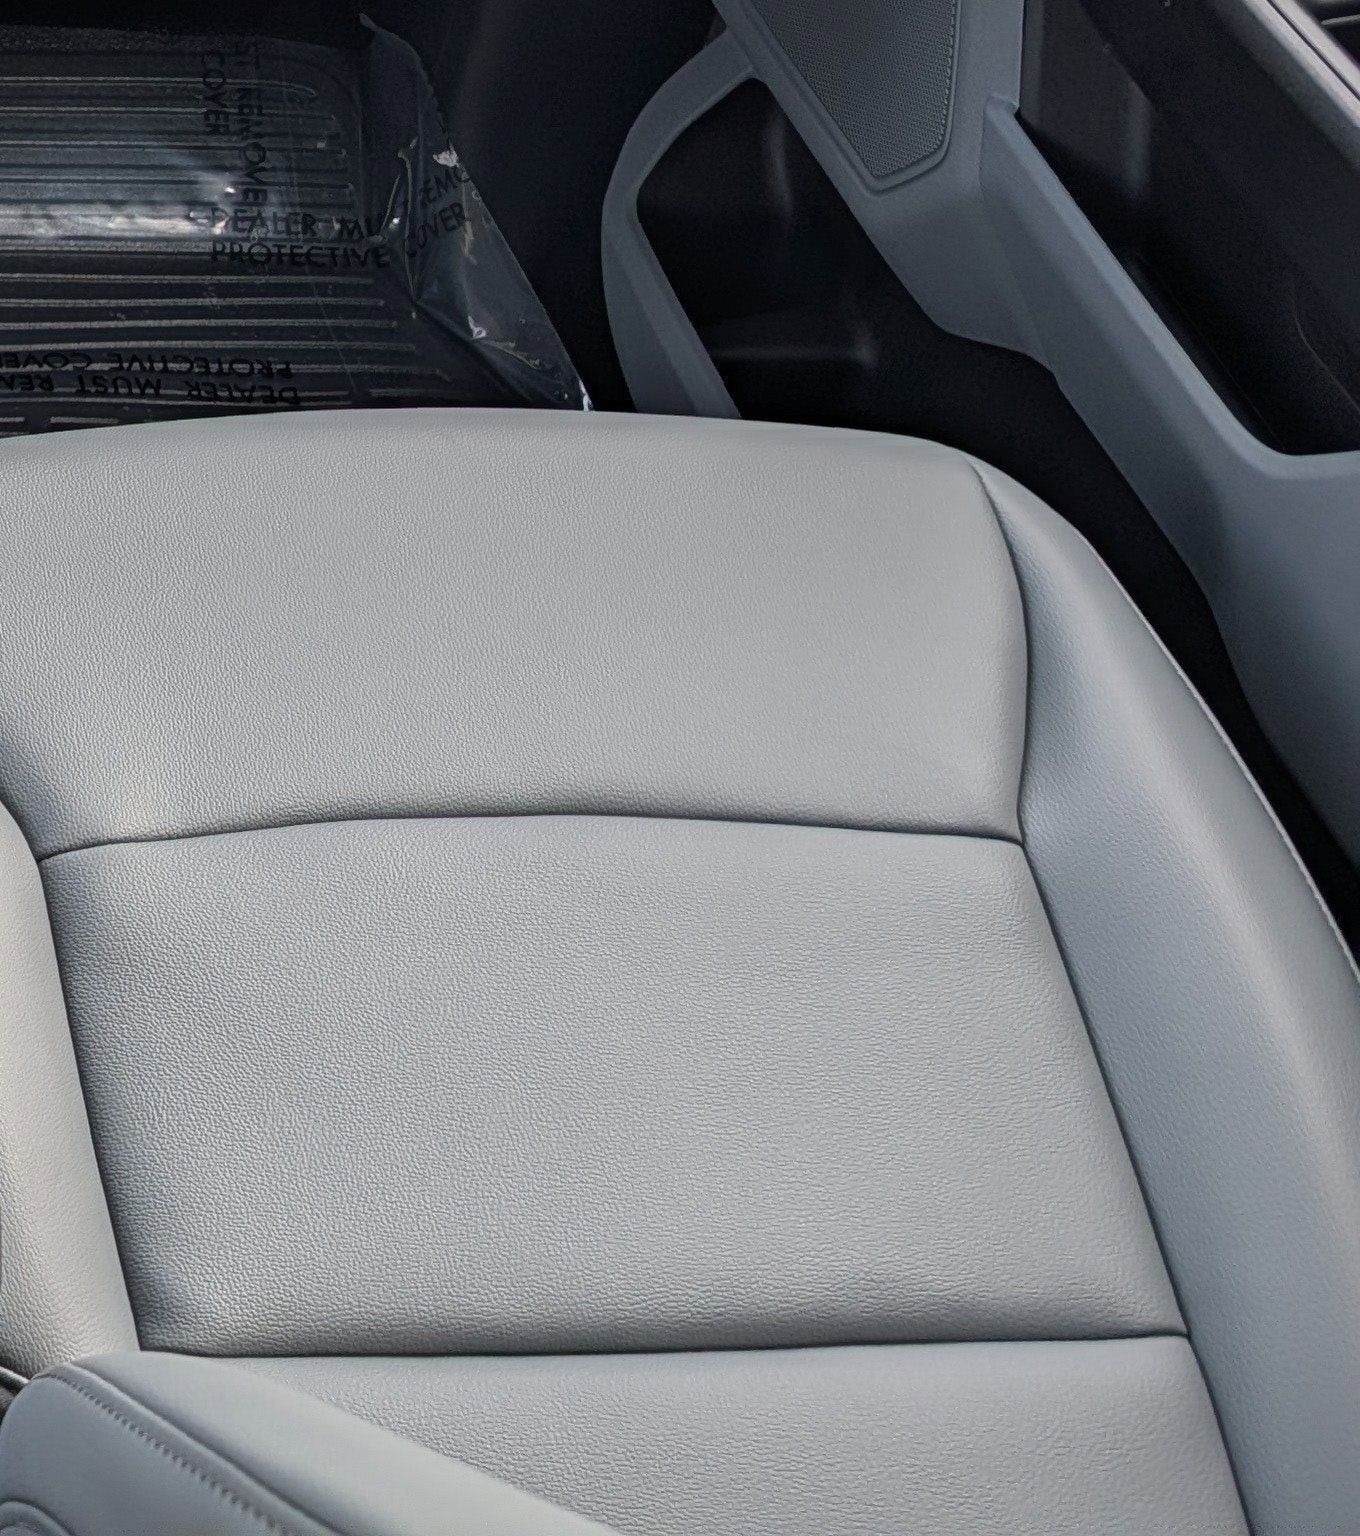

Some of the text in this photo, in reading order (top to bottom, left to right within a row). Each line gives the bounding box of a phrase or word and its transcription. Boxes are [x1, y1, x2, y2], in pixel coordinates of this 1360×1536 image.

[200, 50, 232, 134] COVER
[210, 239, 392, 268] PROTECTIVE
[106, 351, 294, 379] PROTECTIVE
[75, 375, 163, 396] MUST
[184, 379, 301, 404] DEALER
